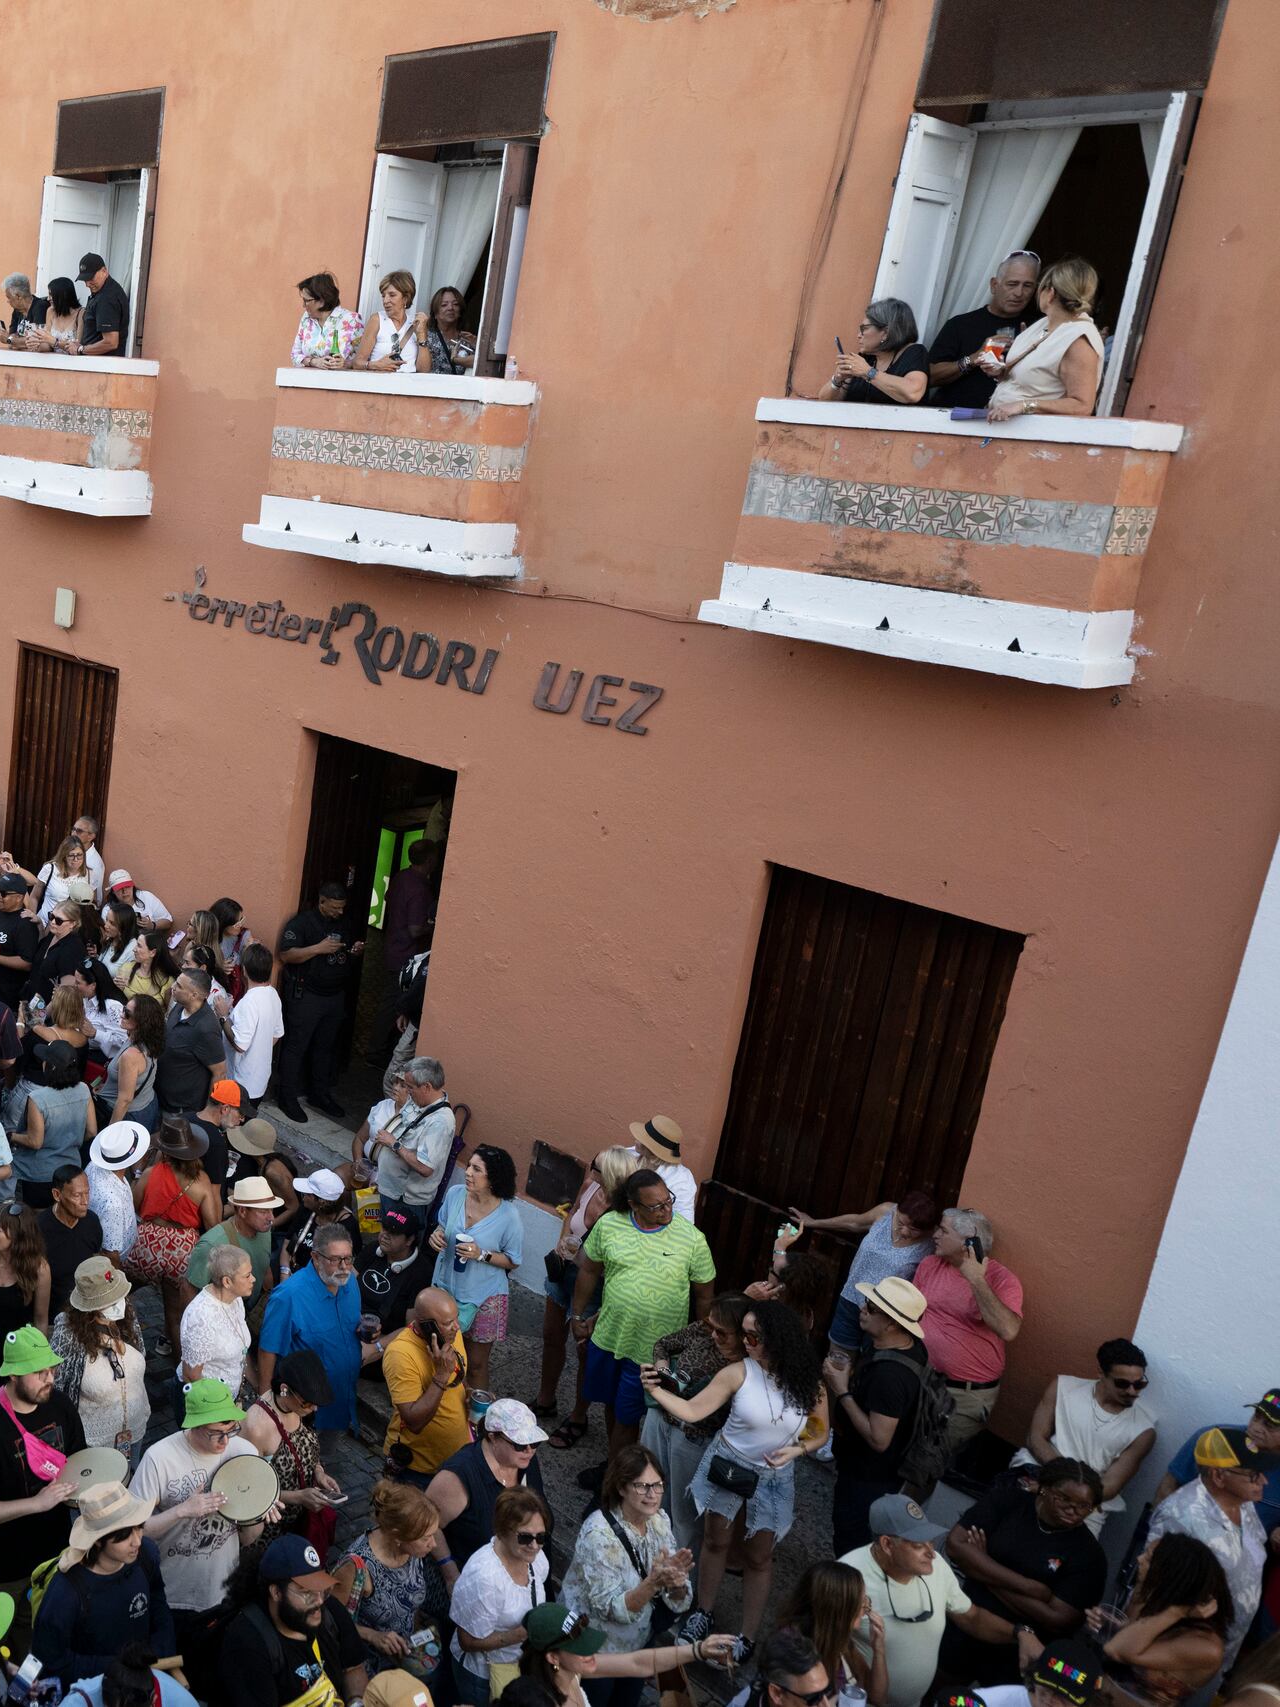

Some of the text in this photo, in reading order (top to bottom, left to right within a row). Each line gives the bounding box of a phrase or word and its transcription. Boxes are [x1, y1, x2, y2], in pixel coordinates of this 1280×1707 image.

[334, 602, 665, 736] RODRI UEZ
[1048, 1656, 1087, 1685] SANSE
[949, 1696, 985, 1707] SAN
